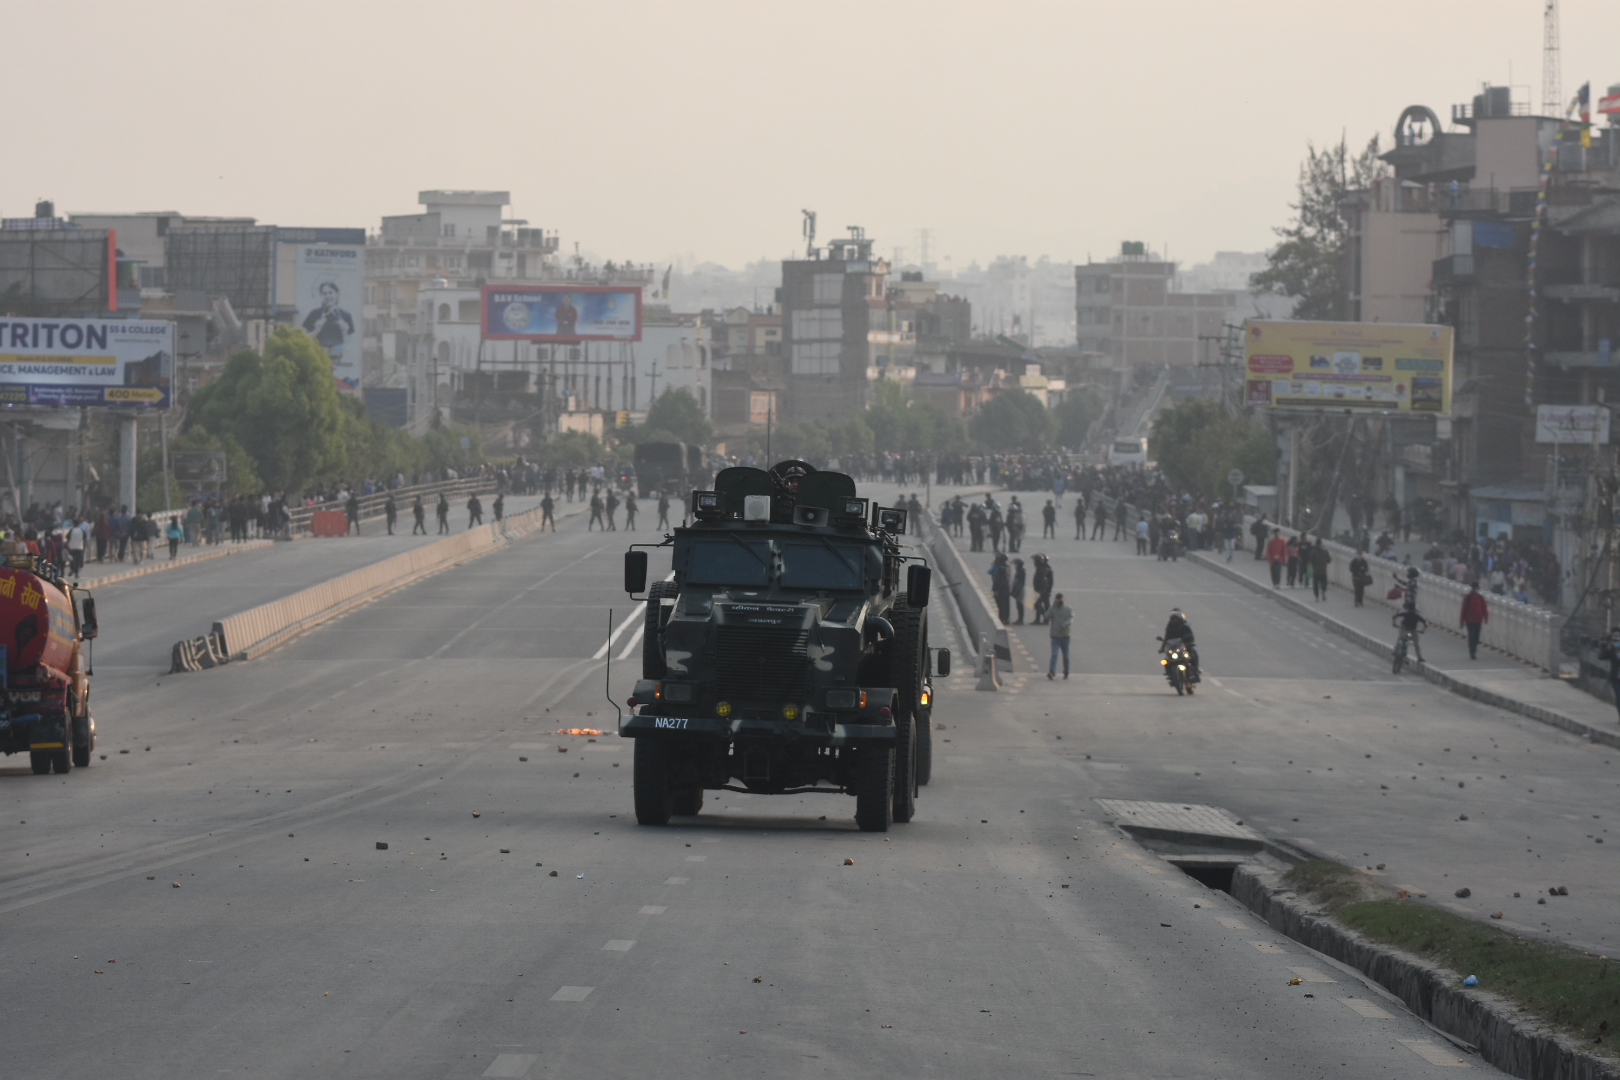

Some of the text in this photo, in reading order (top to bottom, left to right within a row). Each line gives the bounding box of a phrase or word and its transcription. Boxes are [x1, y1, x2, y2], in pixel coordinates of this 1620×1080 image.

[128, 325, 167, 334] COLLEGE
[0, 364, 16, 376] CE,
[18, 365, 86, 376] MANAGEMENT
[95, 367, 117, 376] LAW
[108, 389, 130, 399] 400
[21, 581, 42, 610] सेवा
[654, 717, 689, 730] NA277
